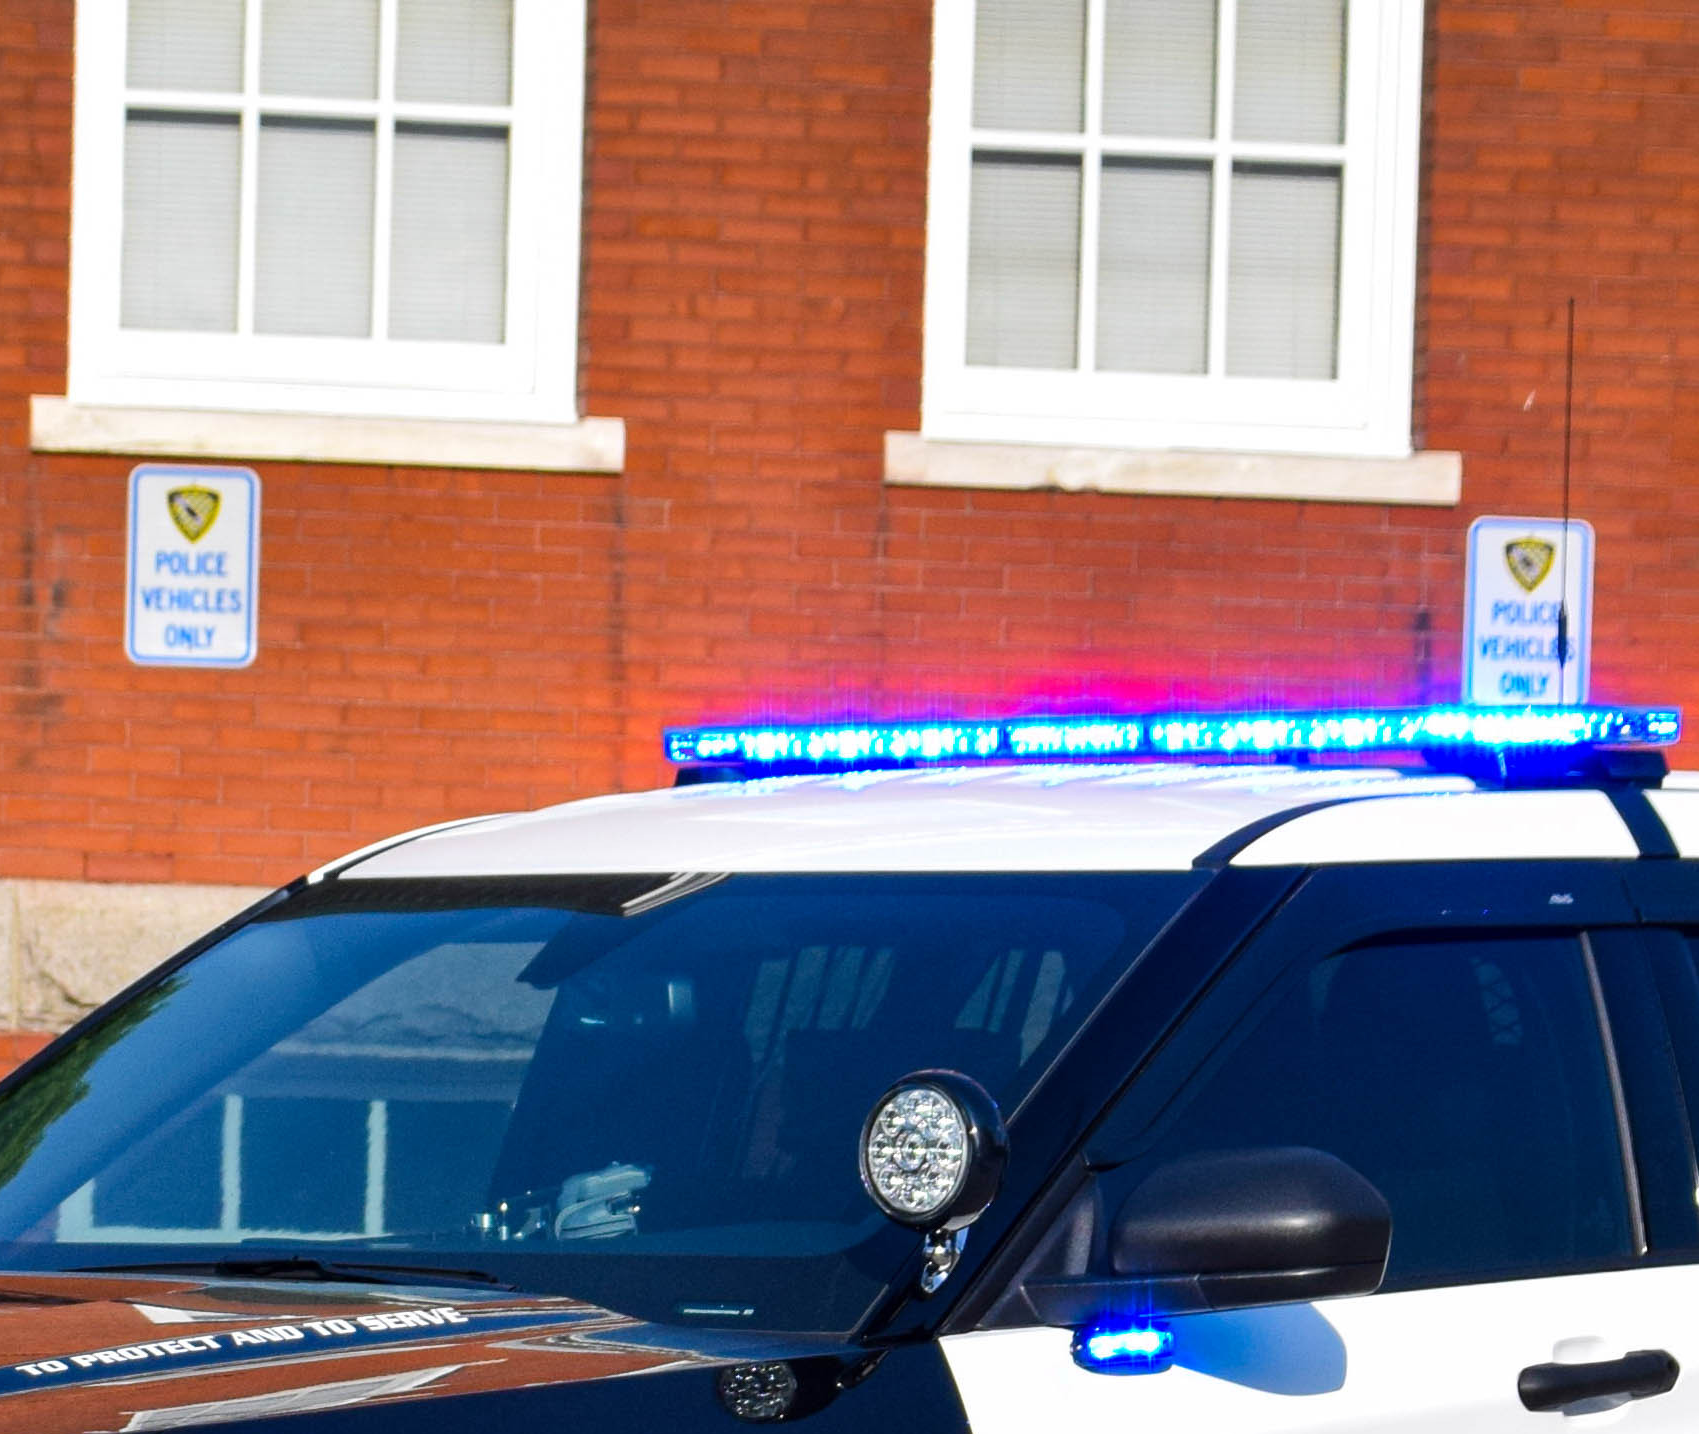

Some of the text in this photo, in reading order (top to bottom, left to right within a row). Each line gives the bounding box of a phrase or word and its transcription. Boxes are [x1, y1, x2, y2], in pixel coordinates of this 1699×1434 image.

[155, 552, 228, 577] POLICE
[141, 588, 241, 613] VEHICLES
[164, 624, 216, 649] ONLY
[1499, 673, 1549, 697] ONLY
[15, 1307, 469, 1376] TO PROTECT AND TO SERVE
